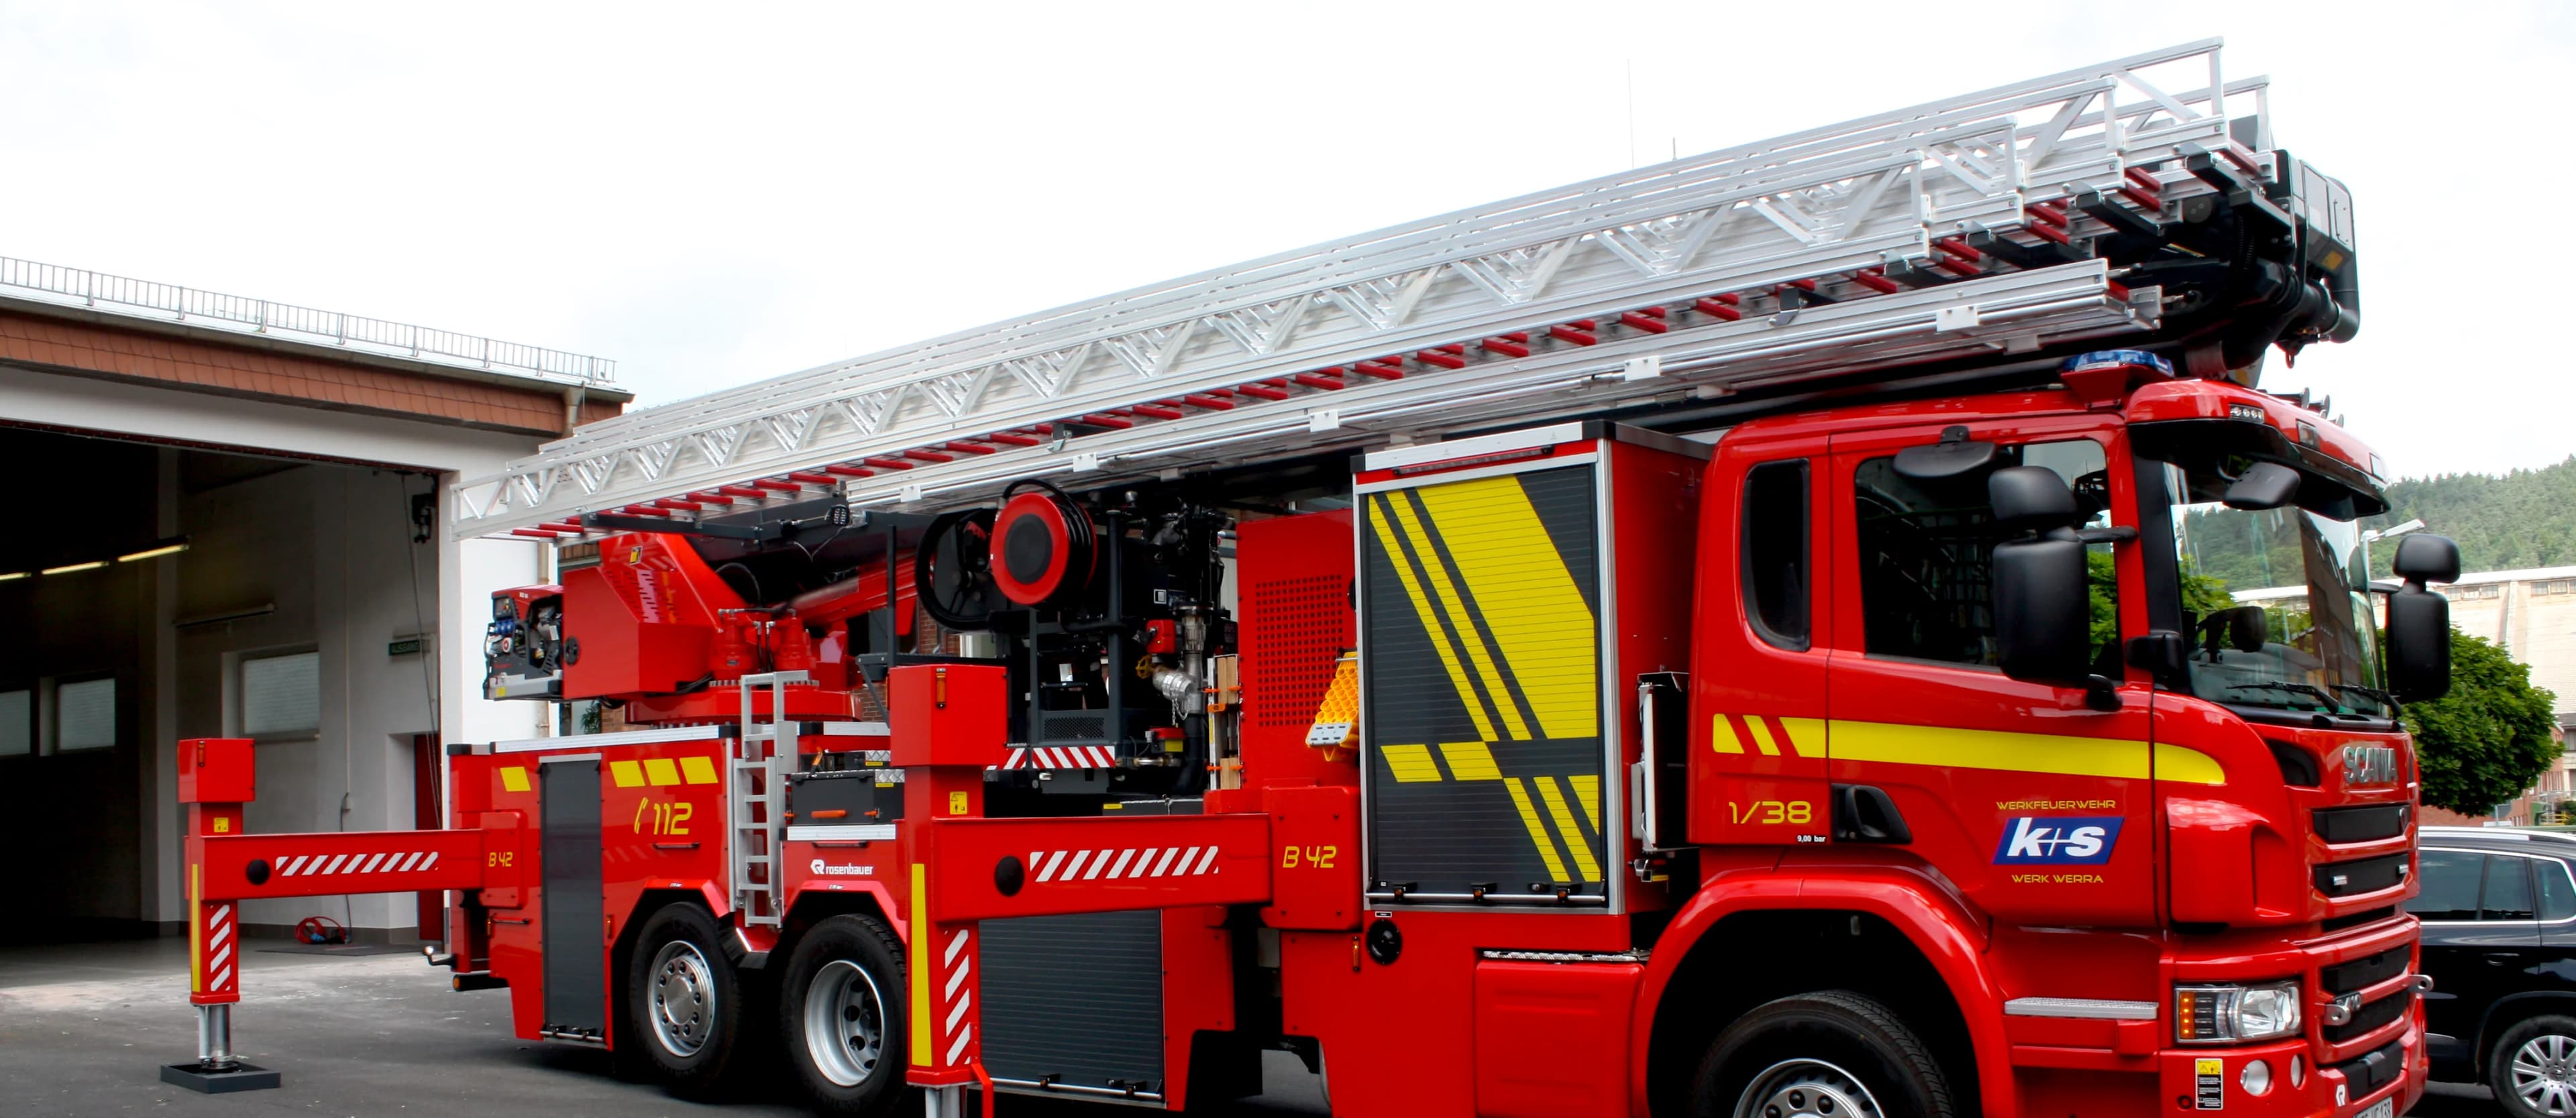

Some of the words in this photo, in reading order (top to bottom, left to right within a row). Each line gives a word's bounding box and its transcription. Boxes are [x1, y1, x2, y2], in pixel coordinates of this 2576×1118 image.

[2343, 746, 2398, 783] SCANIA
[1728, 800, 1811, 824] 1/38
[1996, 800, 2116, 809] WERKFEUERWEHR
[653, 801, 693, 836] 112
[1796, 834, 1812, 842] 9,00
[1813, 834, 1826, 842] bar
[488, 852, 496, 867] B
[498, 852, 513, 867] 42
[1282, 846, 1300, 869] B
[1305, 846, 1337, 869] 42
[825, 862, 873, 875] rosenbauer
[2012, 875, 2049, 883] WERK
[2053, 875, 2104, 883] WERRA
